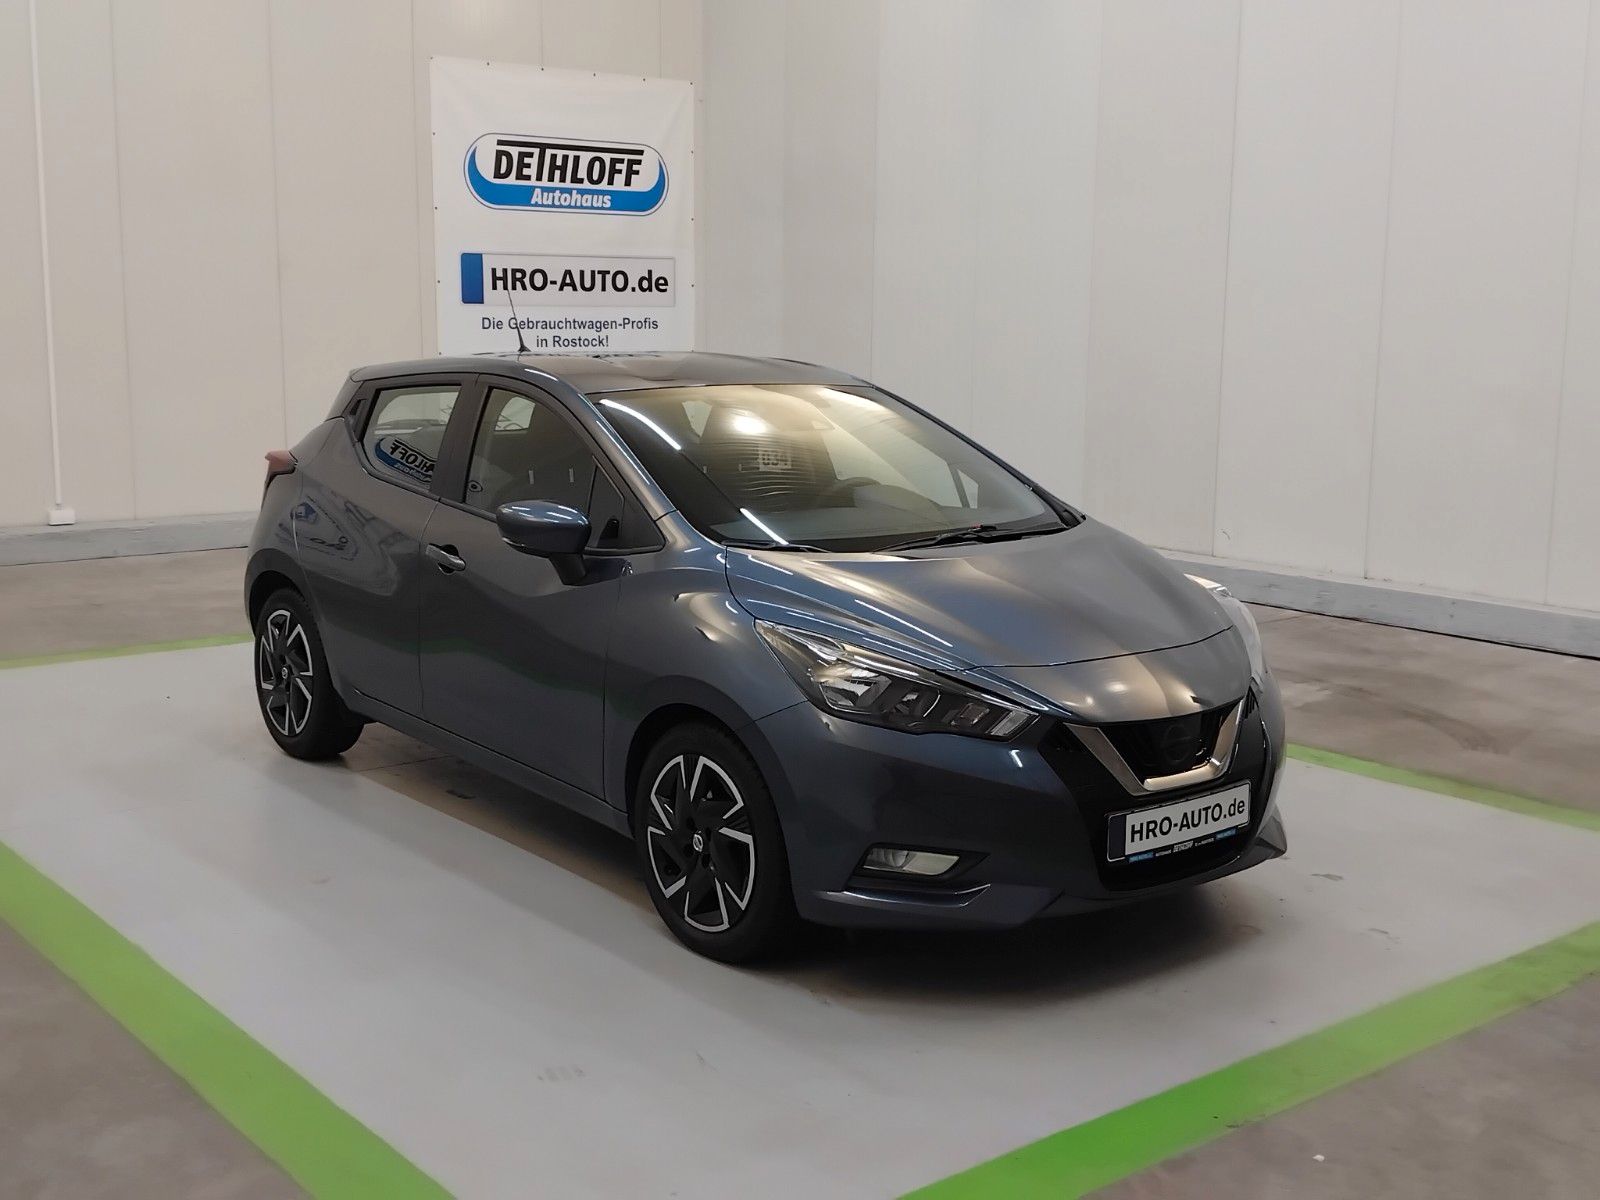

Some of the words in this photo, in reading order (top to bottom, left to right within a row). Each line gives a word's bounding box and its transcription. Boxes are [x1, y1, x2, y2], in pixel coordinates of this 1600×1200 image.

[493, 139, 644, 187] DETHLOFF
[531, 188, 612, 208] Autohaus
[491, 267, 669, 293] HRO-AUTO.de
[481, 317, 504, 330] Die
[508, 317, 659, 332] Gebrauchtwagen-Profis
[536, 336, 548, 347] in
[552, 335, 609, 348] Rostock!
[1130, 798, 1245, 843] HRO-AUTO.de
